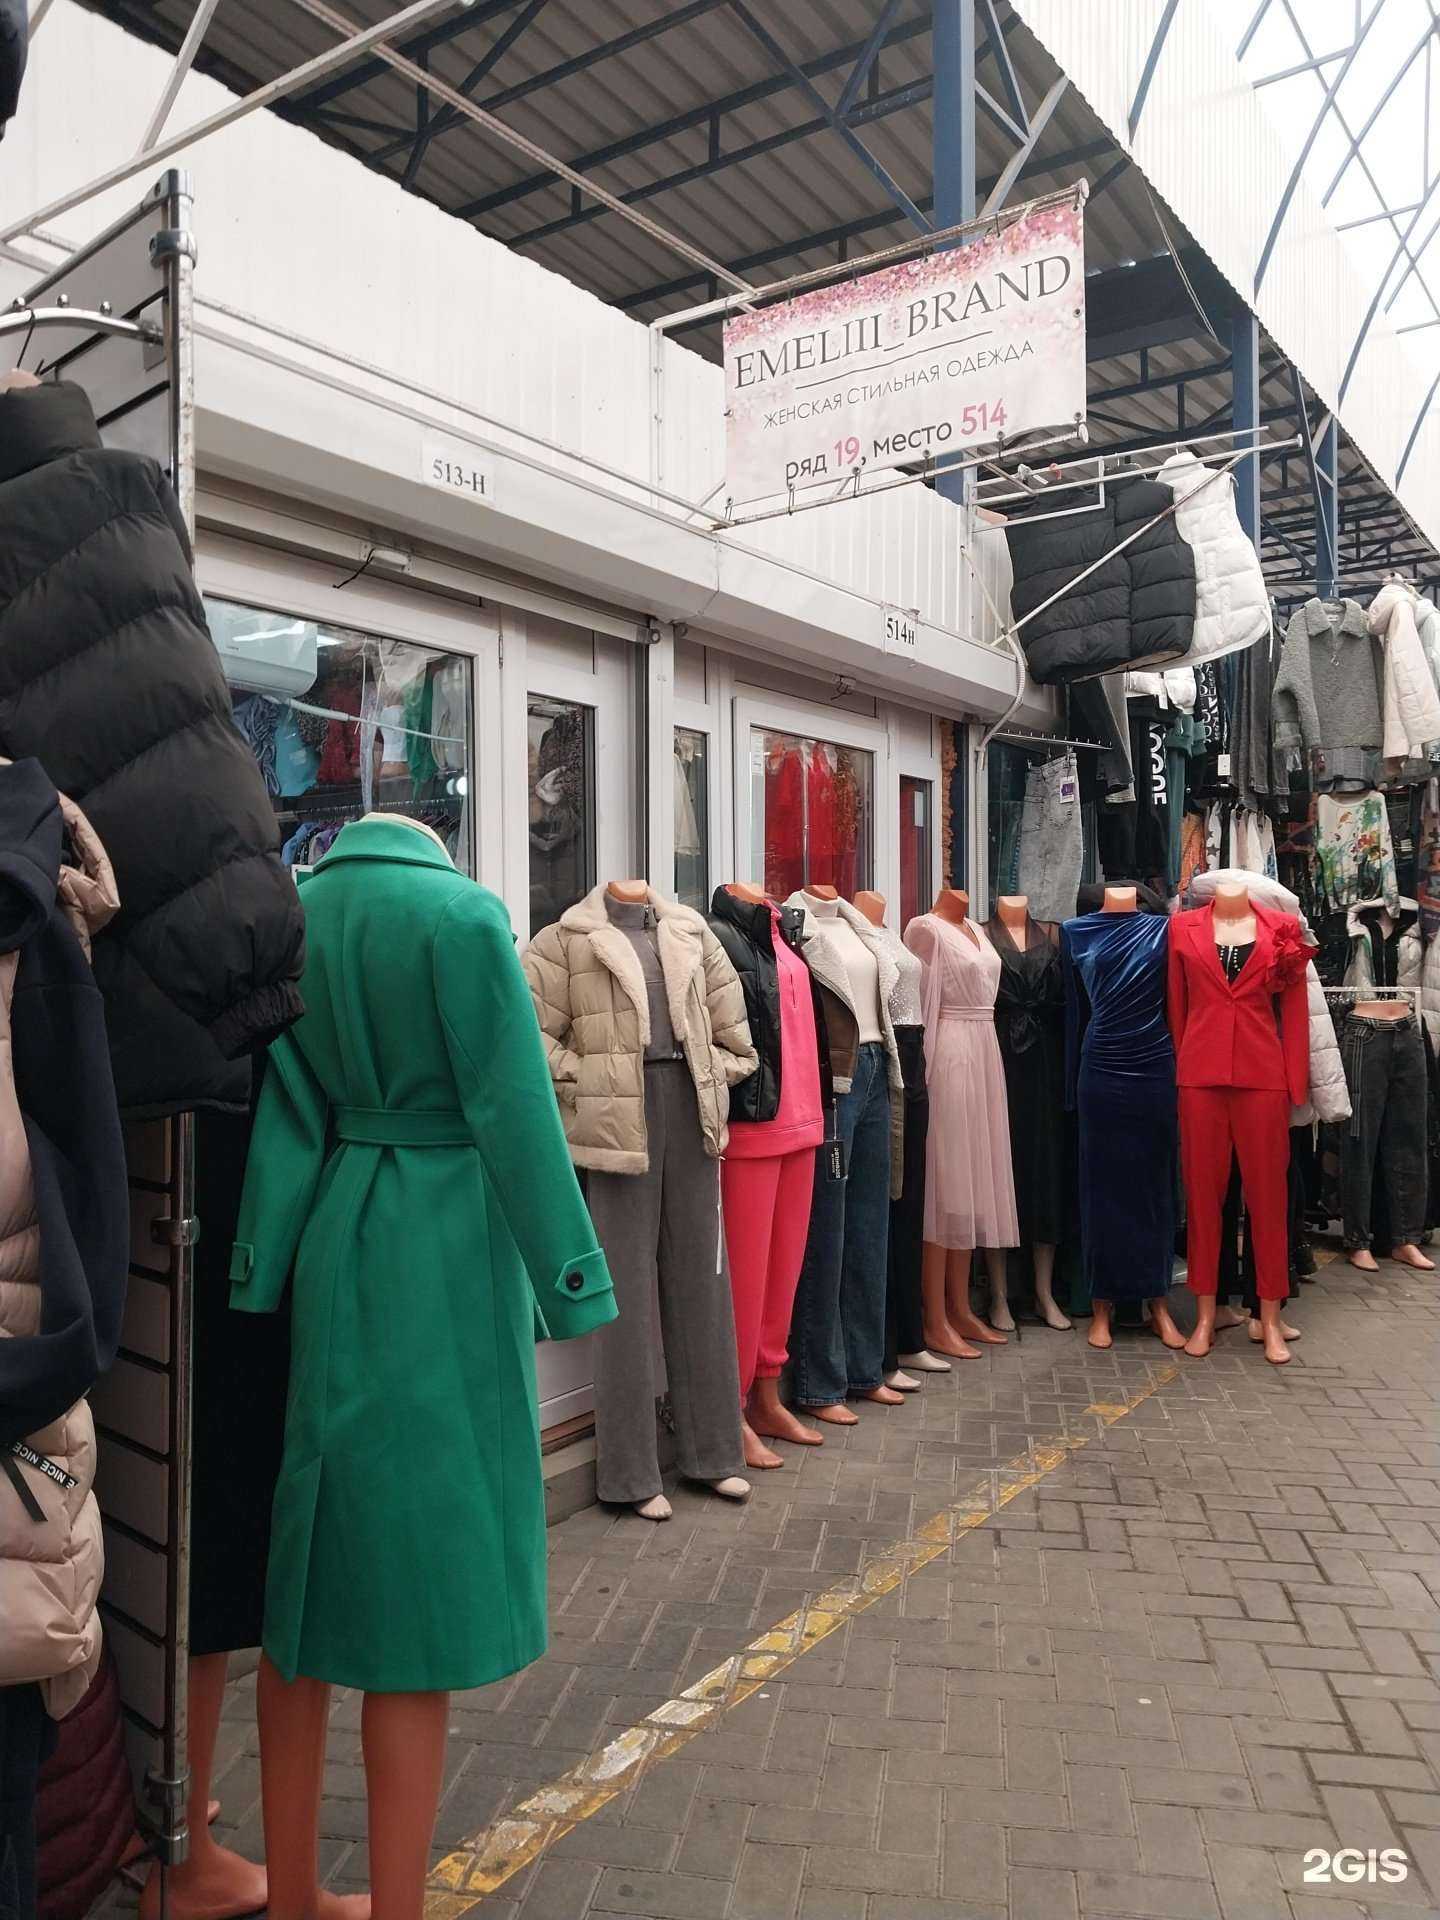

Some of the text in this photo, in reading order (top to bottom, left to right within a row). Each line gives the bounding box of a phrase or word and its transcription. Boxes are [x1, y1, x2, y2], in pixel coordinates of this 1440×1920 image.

[762, 339, 1035, 430] ЖЕНСКАЯ СТИЛЬНАЯ ОДЕЖДА
[785, 398, 1008, 485] ряд 19, место 514
[12, 1441, 39, 1465] NICE
[39, 1459, 67, 1484] NICE
